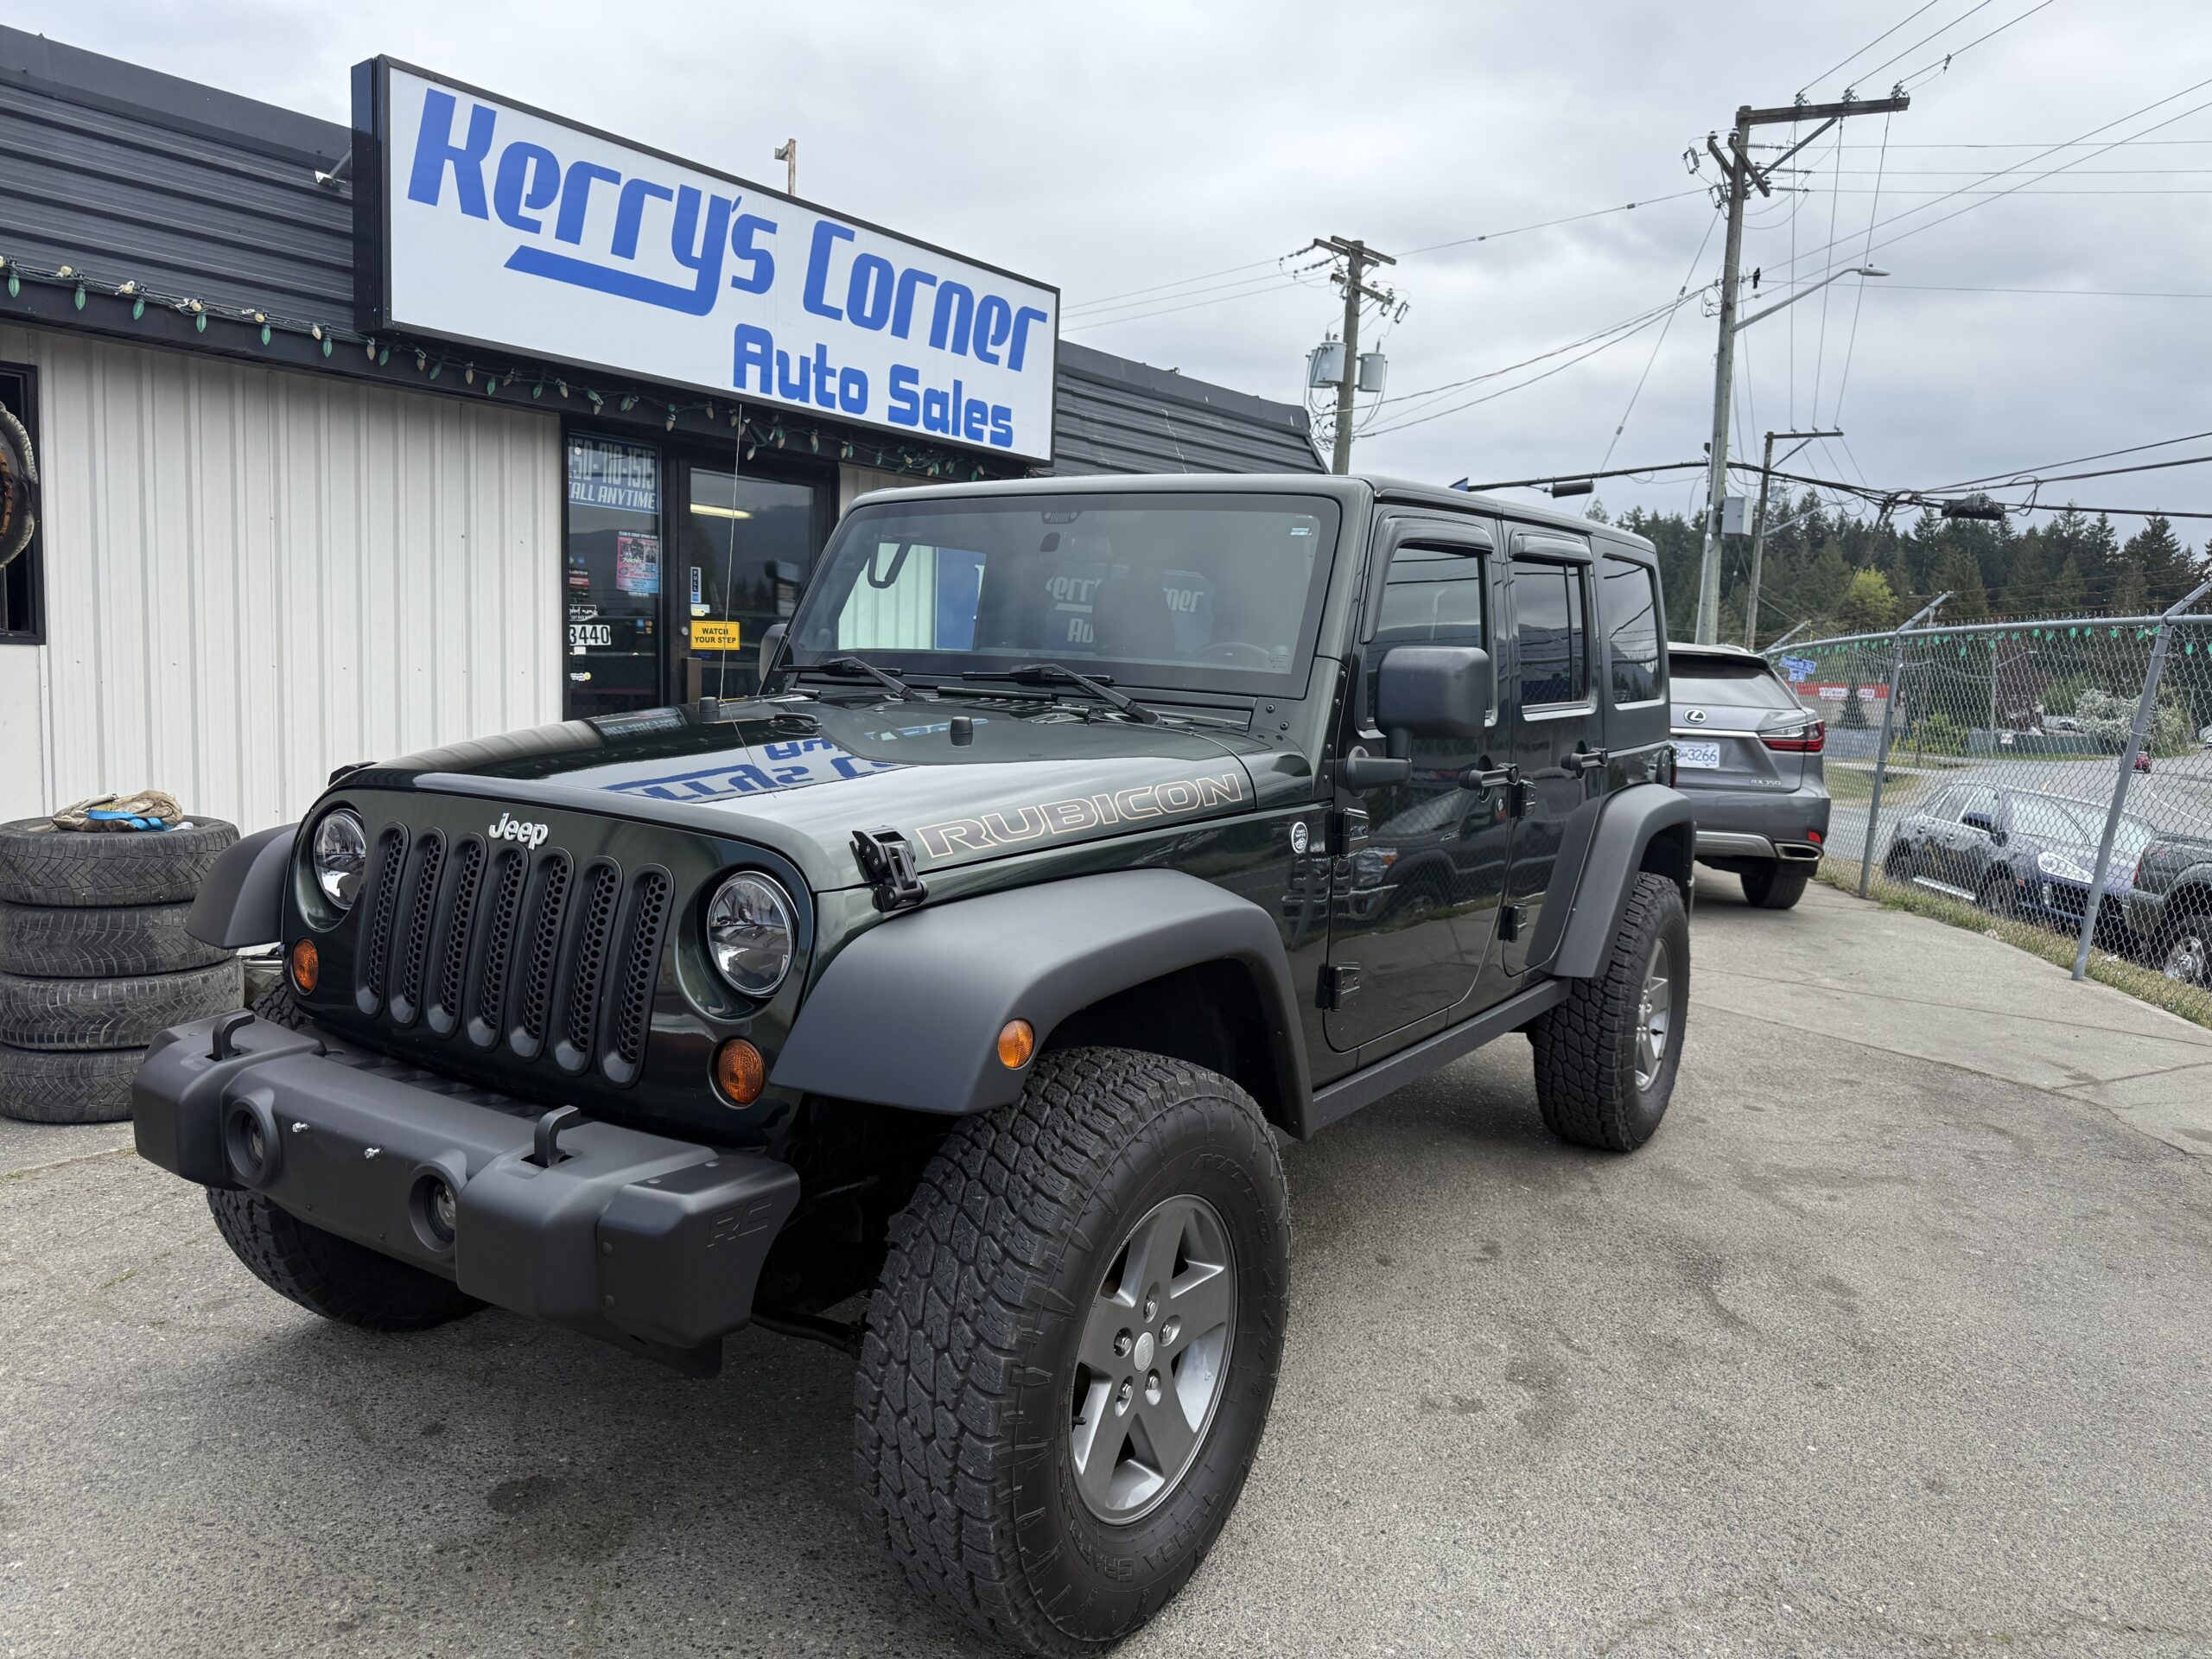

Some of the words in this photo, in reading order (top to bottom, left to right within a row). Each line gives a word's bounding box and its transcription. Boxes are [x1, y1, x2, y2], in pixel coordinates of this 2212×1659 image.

[407, 87, 779, 317] Kerry's
[803, 219, 1048, 372] Corner
[732, 322, 868, 416] Auto
[887, 363, 1014, 449] Sales
[597, 486, 657, 509] ANYTIME
[569, 626, 609, 645] 3440
[488, 812, 550, 849] Jeep
[915, 772, 1243, 860] RUBICON
